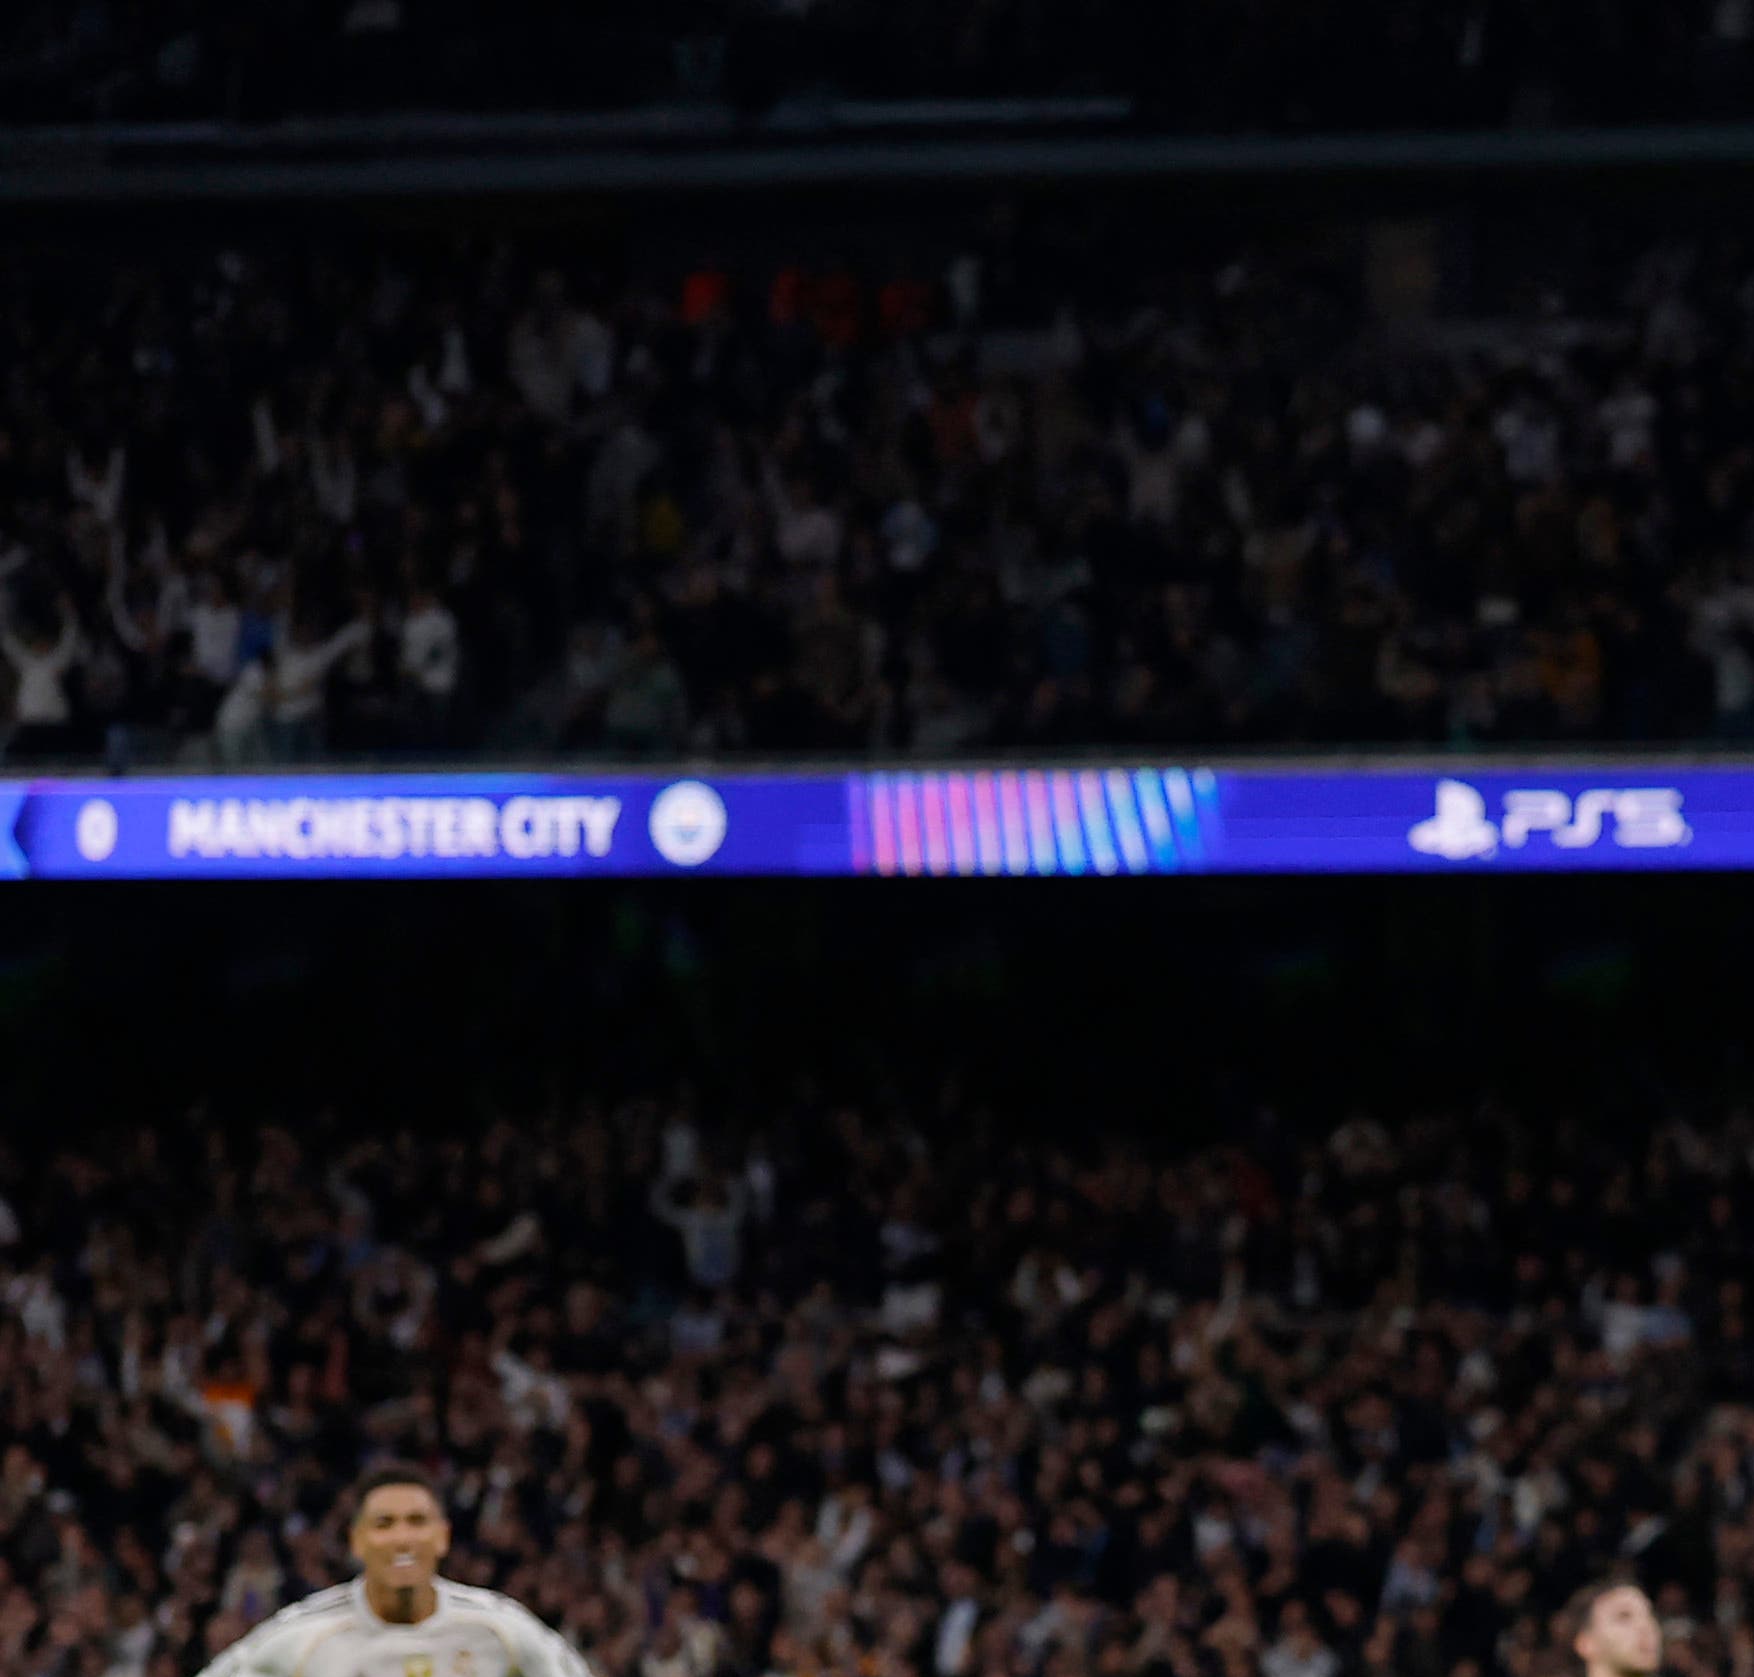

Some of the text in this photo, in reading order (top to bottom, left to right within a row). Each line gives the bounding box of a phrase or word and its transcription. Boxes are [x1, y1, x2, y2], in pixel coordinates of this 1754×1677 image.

[167, 797, 499, 860] MANCHESTER
[502, 796, 621, 859] CITY
[1503, 788, 1691, 848] PS5
